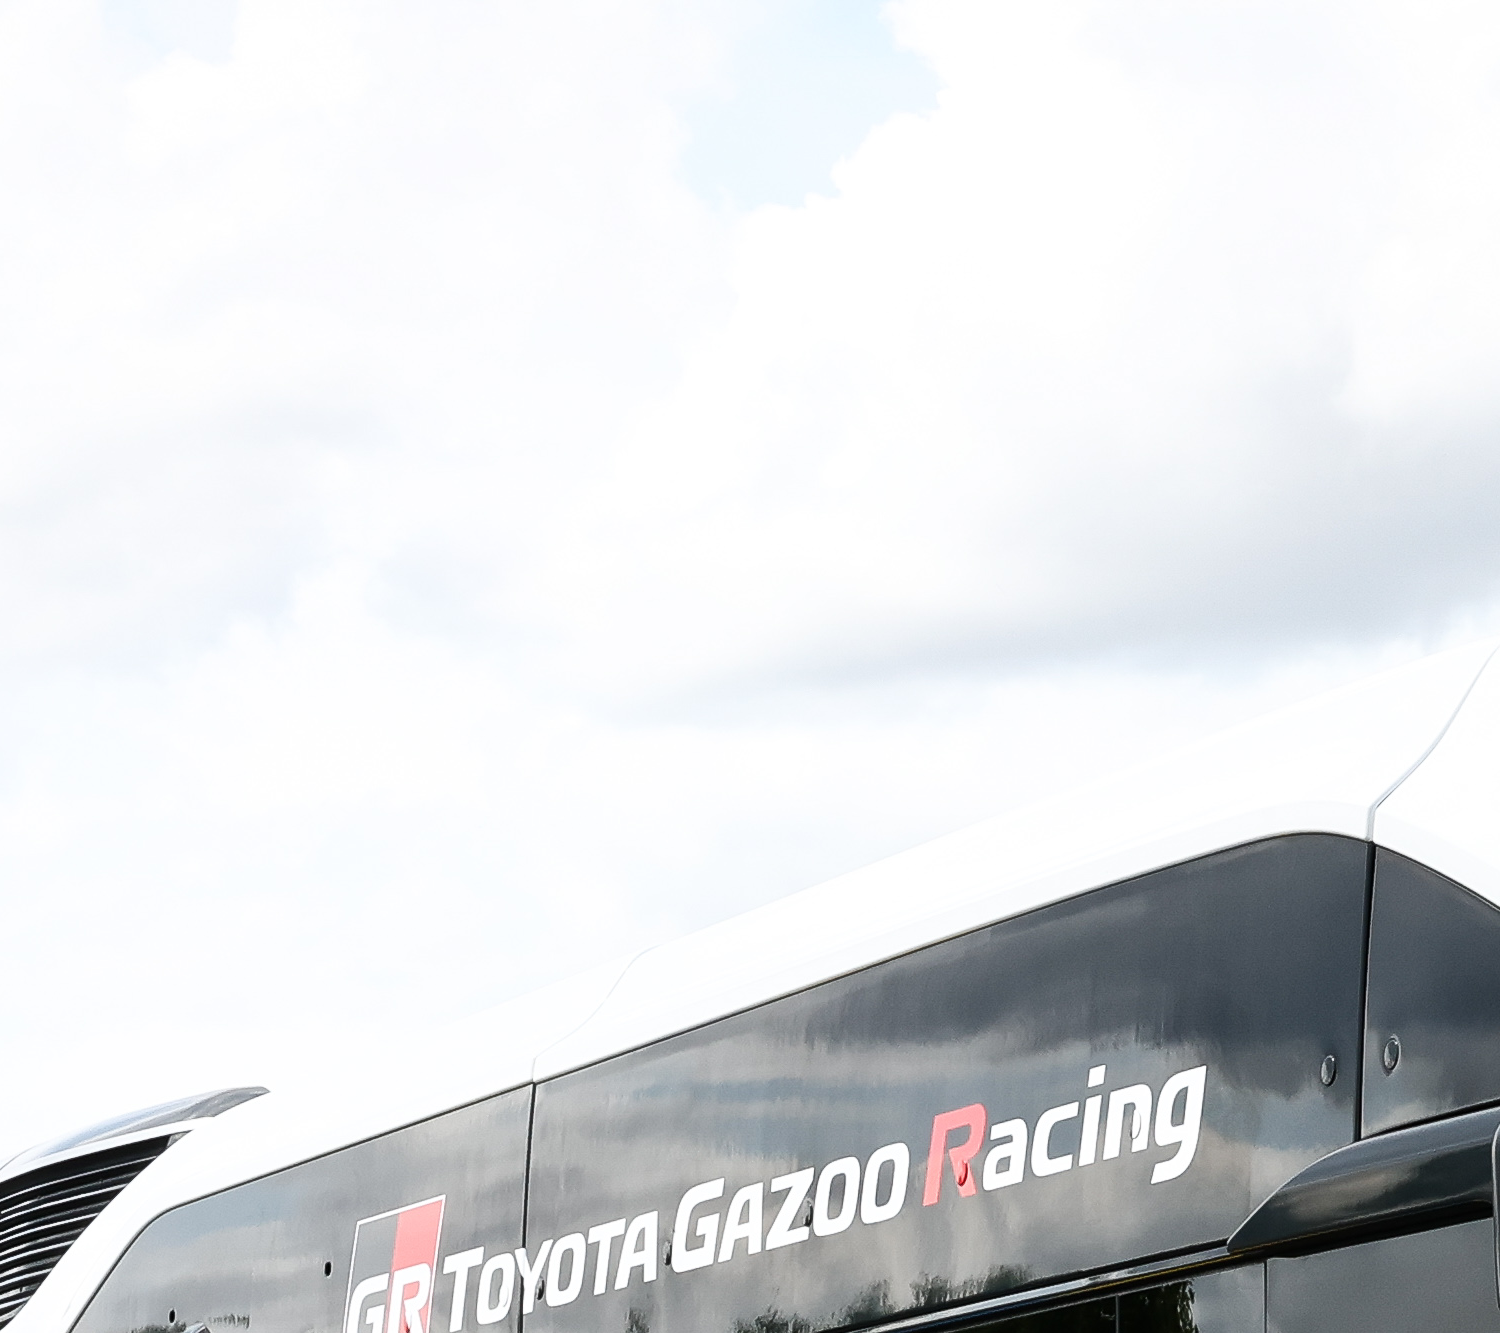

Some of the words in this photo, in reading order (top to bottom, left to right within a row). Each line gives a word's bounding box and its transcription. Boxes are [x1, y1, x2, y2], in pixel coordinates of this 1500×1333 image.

[442, 1210, 659, 1333] TOYOTA
[671, 1142, 910, 1273] GAZOO
[923, 1064, 1207, 1207] Racing
